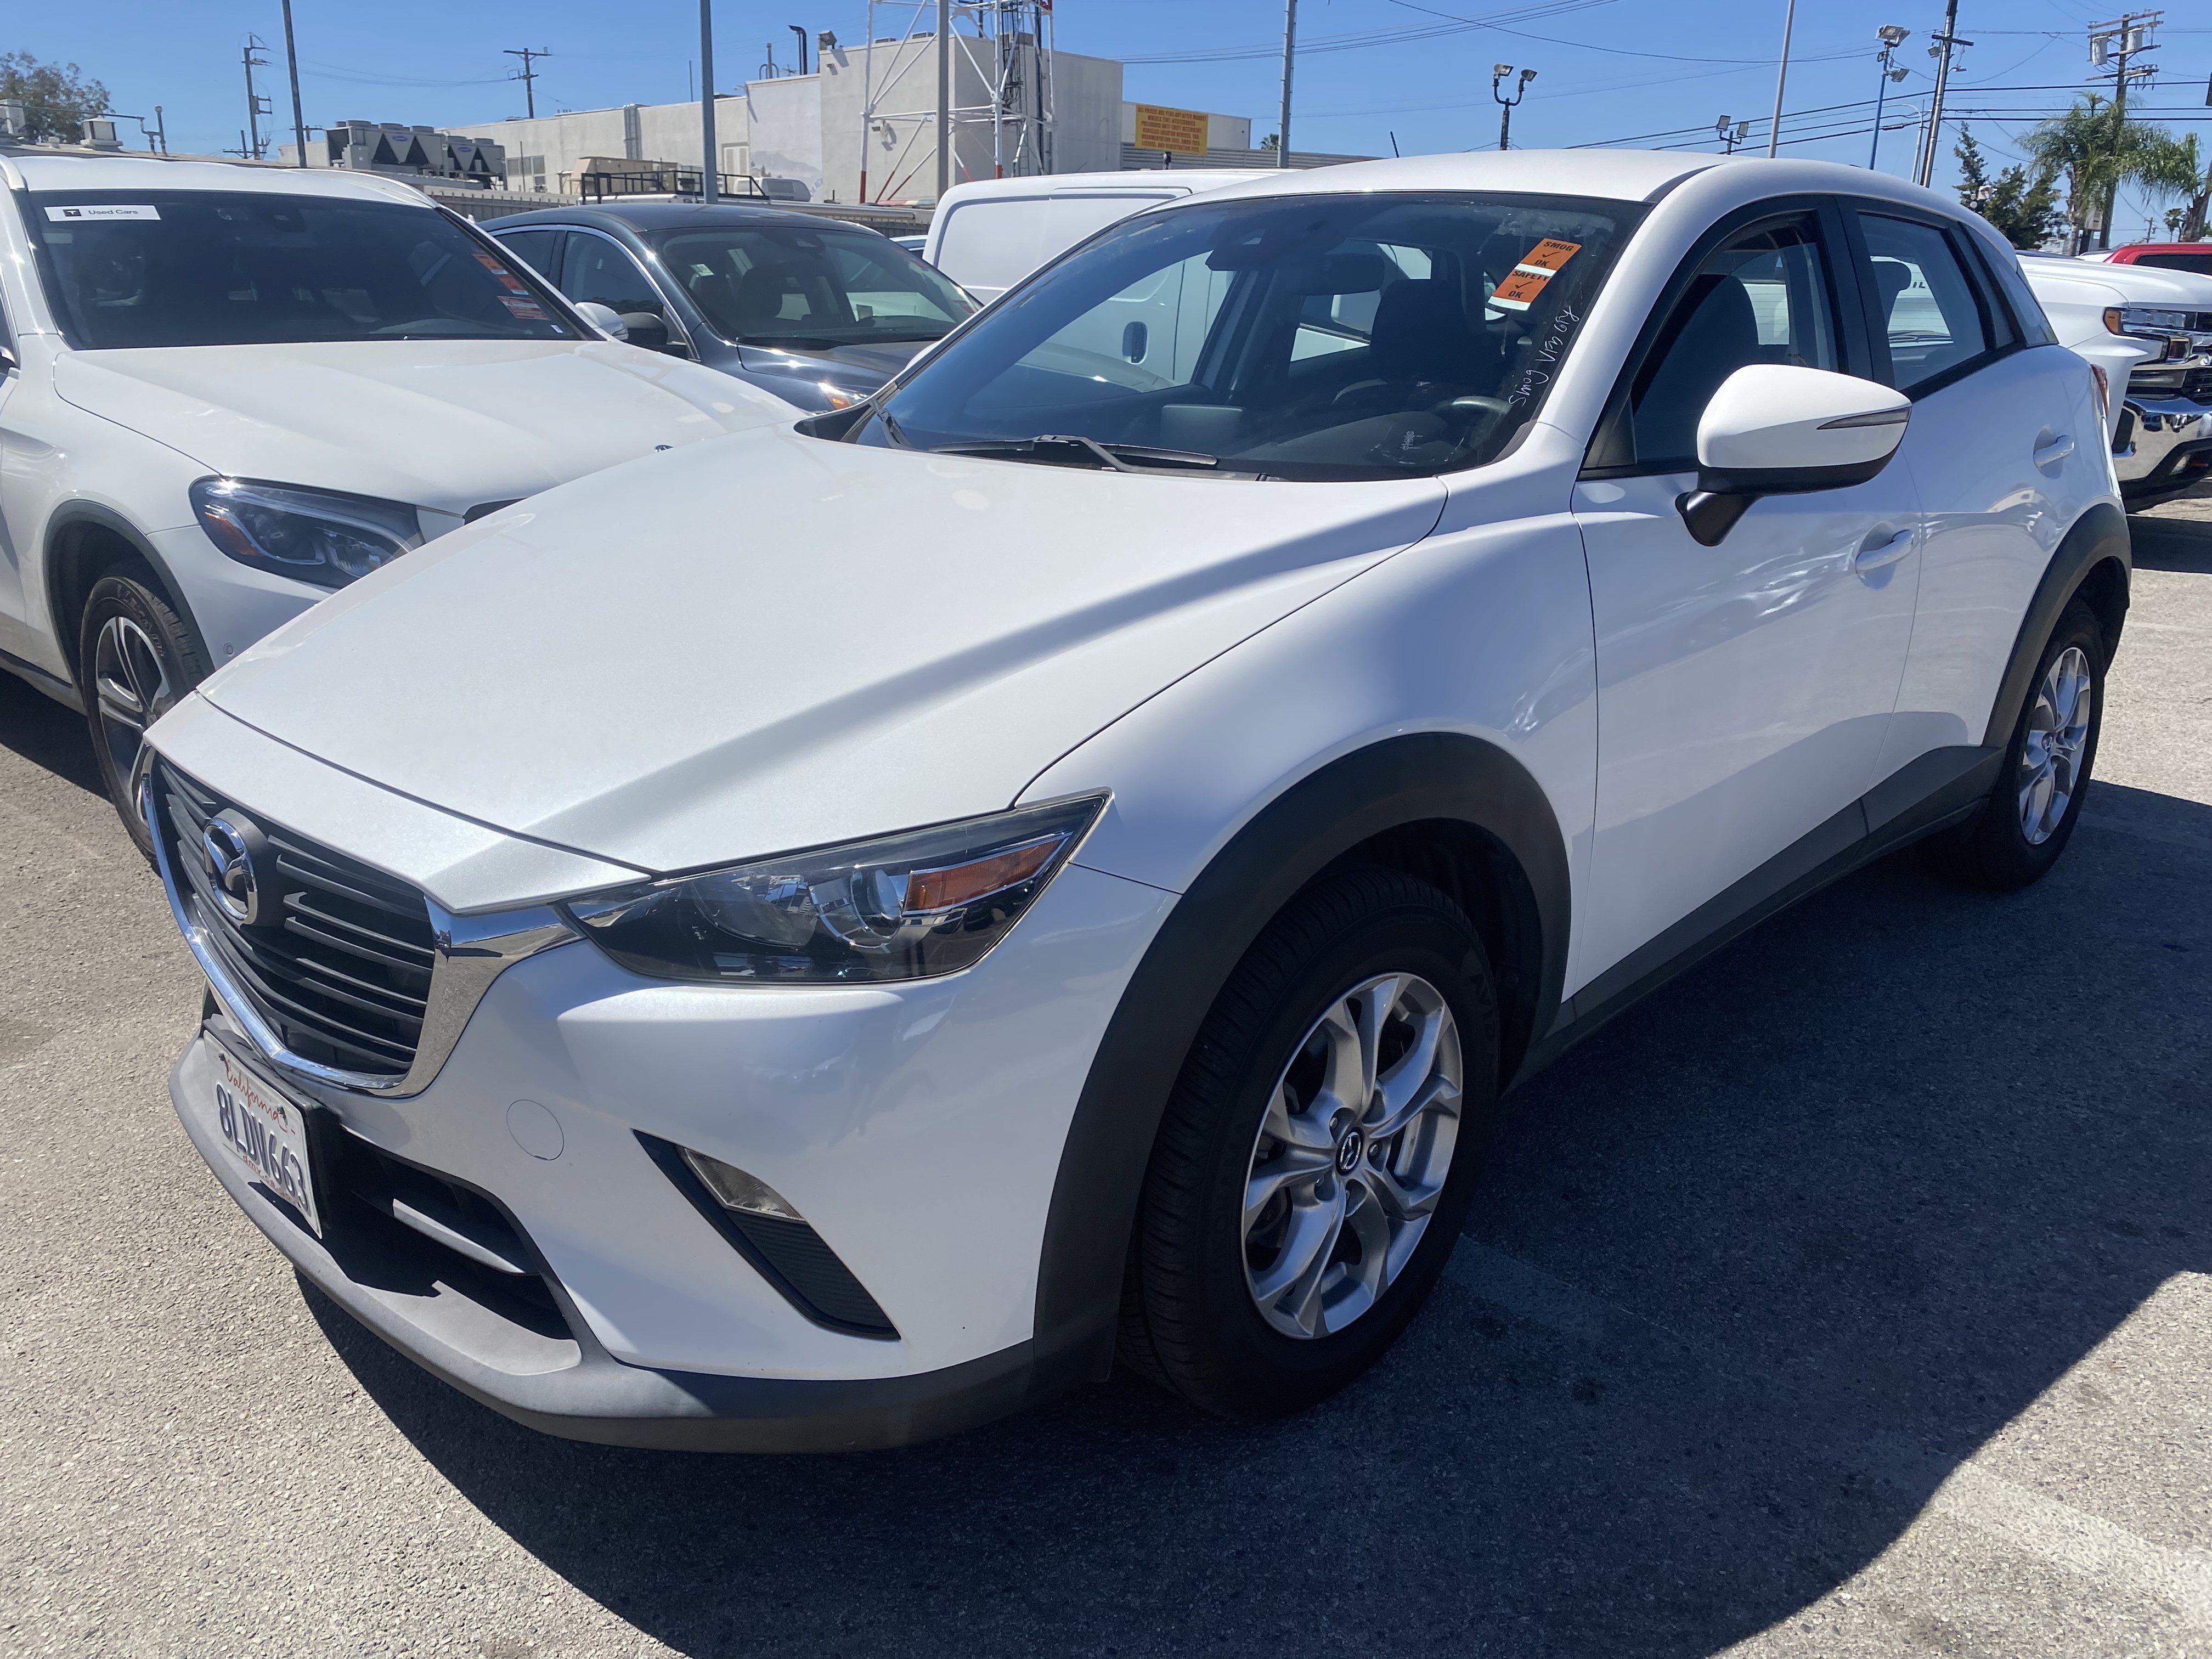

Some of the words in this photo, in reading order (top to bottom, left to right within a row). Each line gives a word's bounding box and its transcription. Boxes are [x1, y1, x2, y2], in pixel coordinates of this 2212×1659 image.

[1543, 241, 1575, 251] SMOG
[1511, 270, 1549, 281] SAFETY
[1508, 290, 1524, 298] OK
[216, 1083, 311, 1216] 8LDV663
